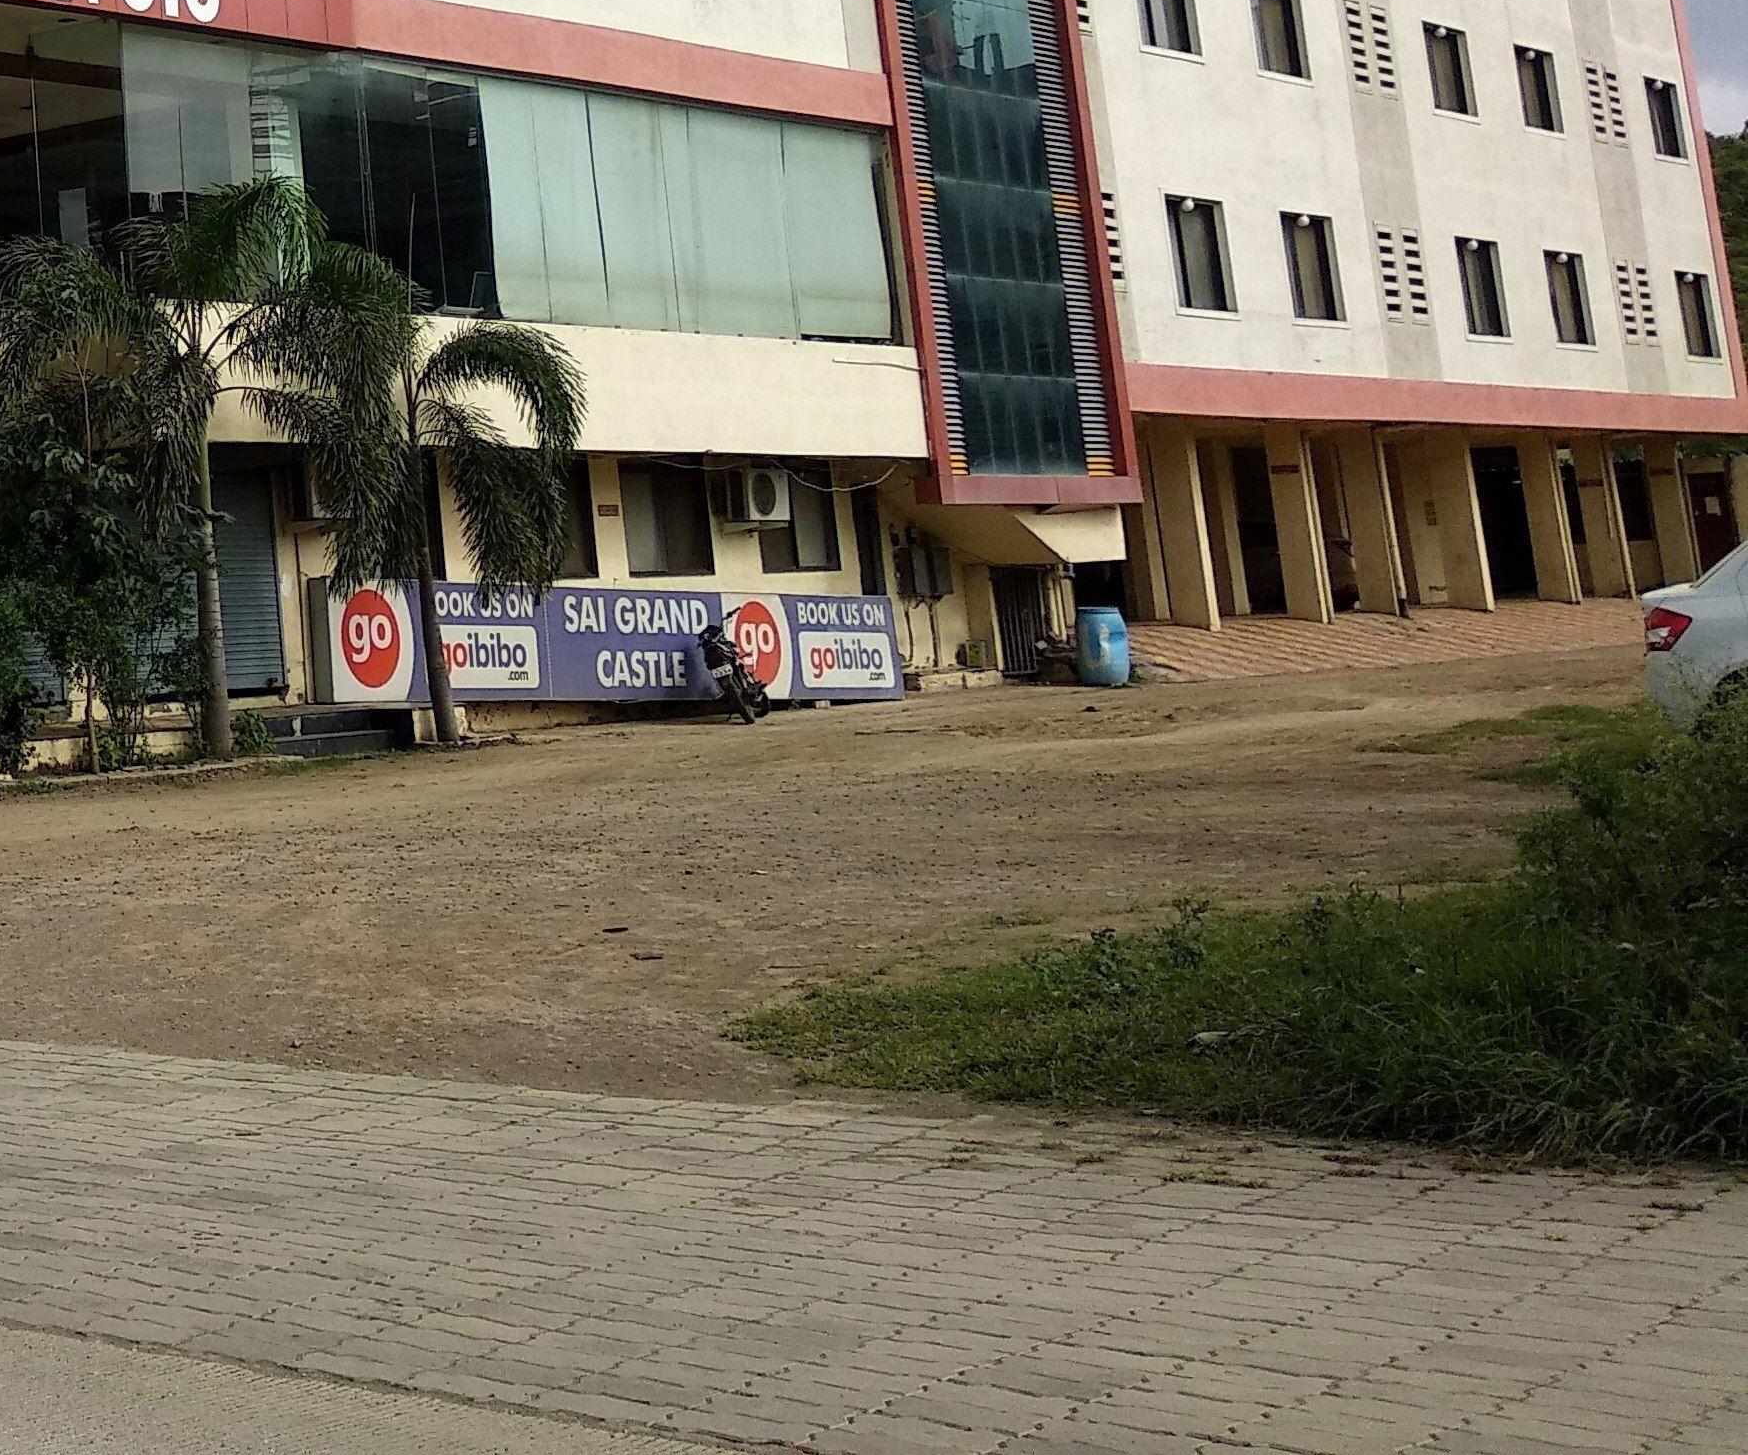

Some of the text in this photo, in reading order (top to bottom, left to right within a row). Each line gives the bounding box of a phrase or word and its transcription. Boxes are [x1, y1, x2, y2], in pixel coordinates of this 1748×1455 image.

[435, 591, 476, 617] OOK
[506, 593, 533, 618] ON
[563, 594, 709, 635] SAI GRAND
[797, 601, 886, 627] BOOK US ON
[348, 614, 393, 663] go
[739, 622, 775, 671] go
[809, 638, 883, 680] goibibo
[596, 650, 688, 688] CASTLE
